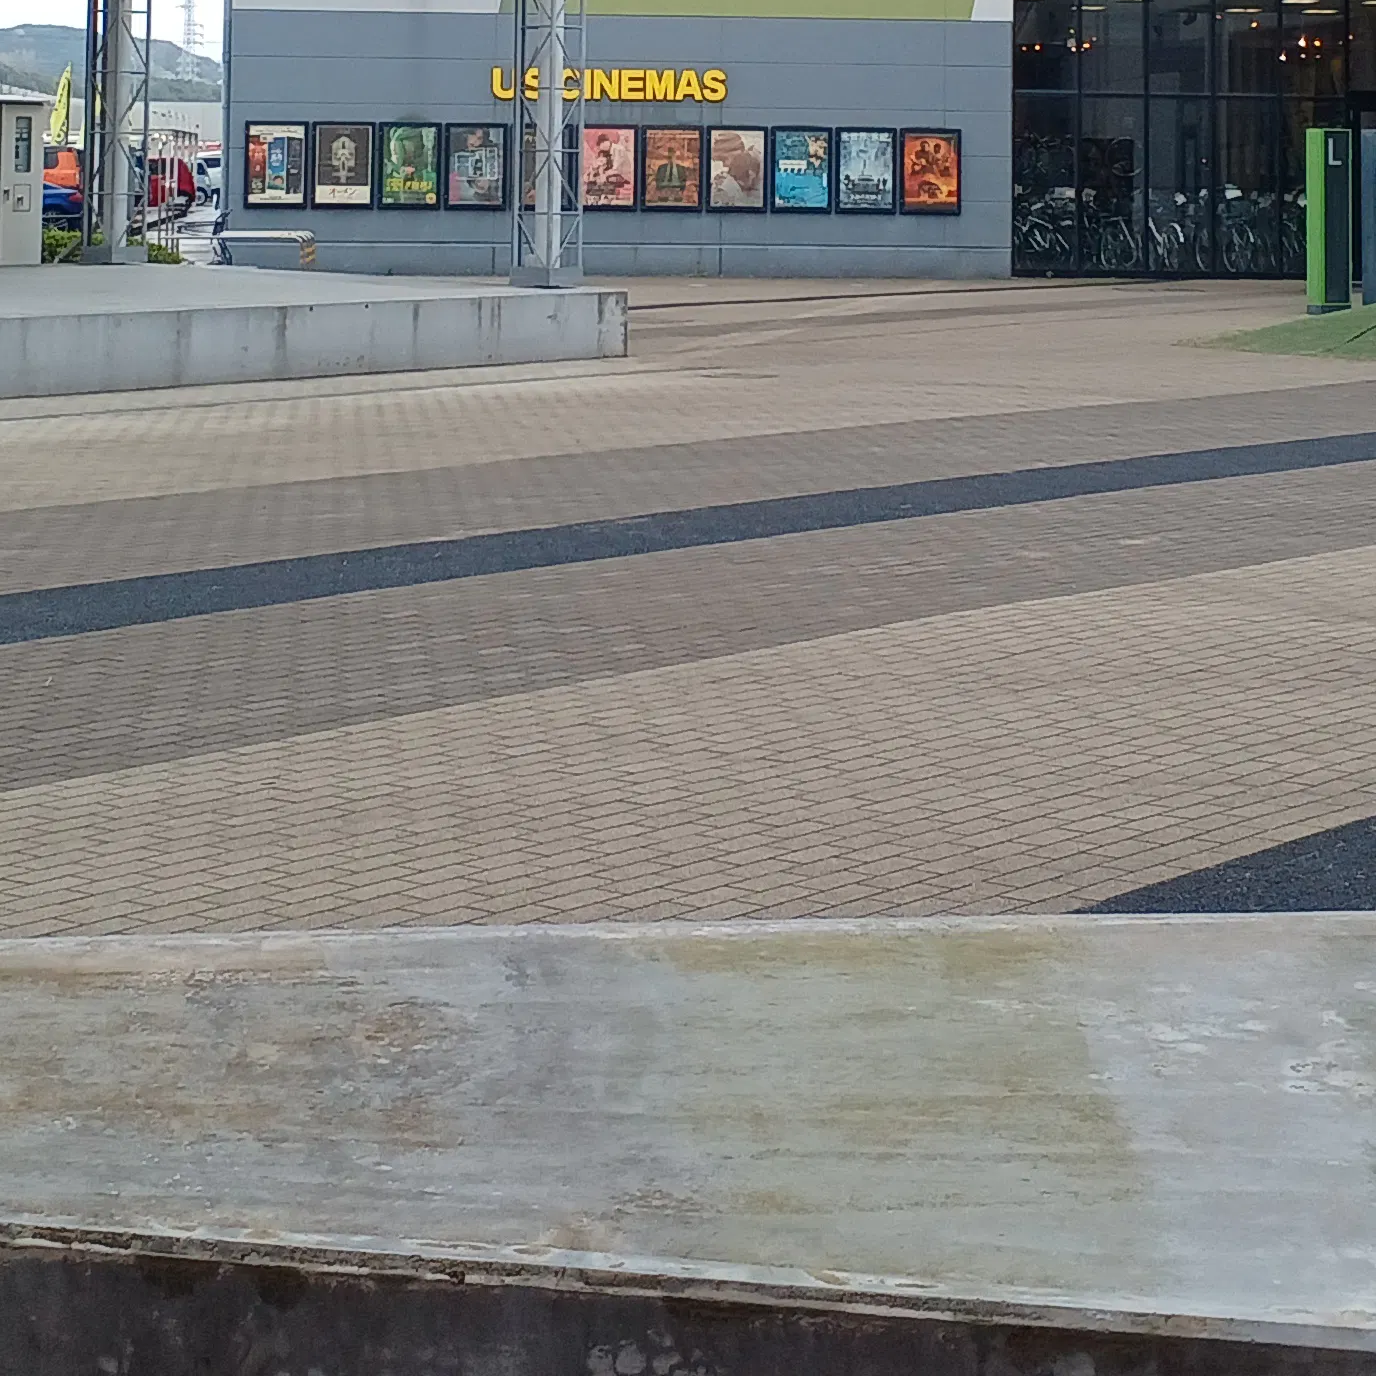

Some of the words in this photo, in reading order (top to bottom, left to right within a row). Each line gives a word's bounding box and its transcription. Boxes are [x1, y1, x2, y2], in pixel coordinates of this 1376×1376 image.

[490, 66, 539, 101] US
[561, 67, 728, 103] CINEMAS
[1327, 137, 1342, 166] L
